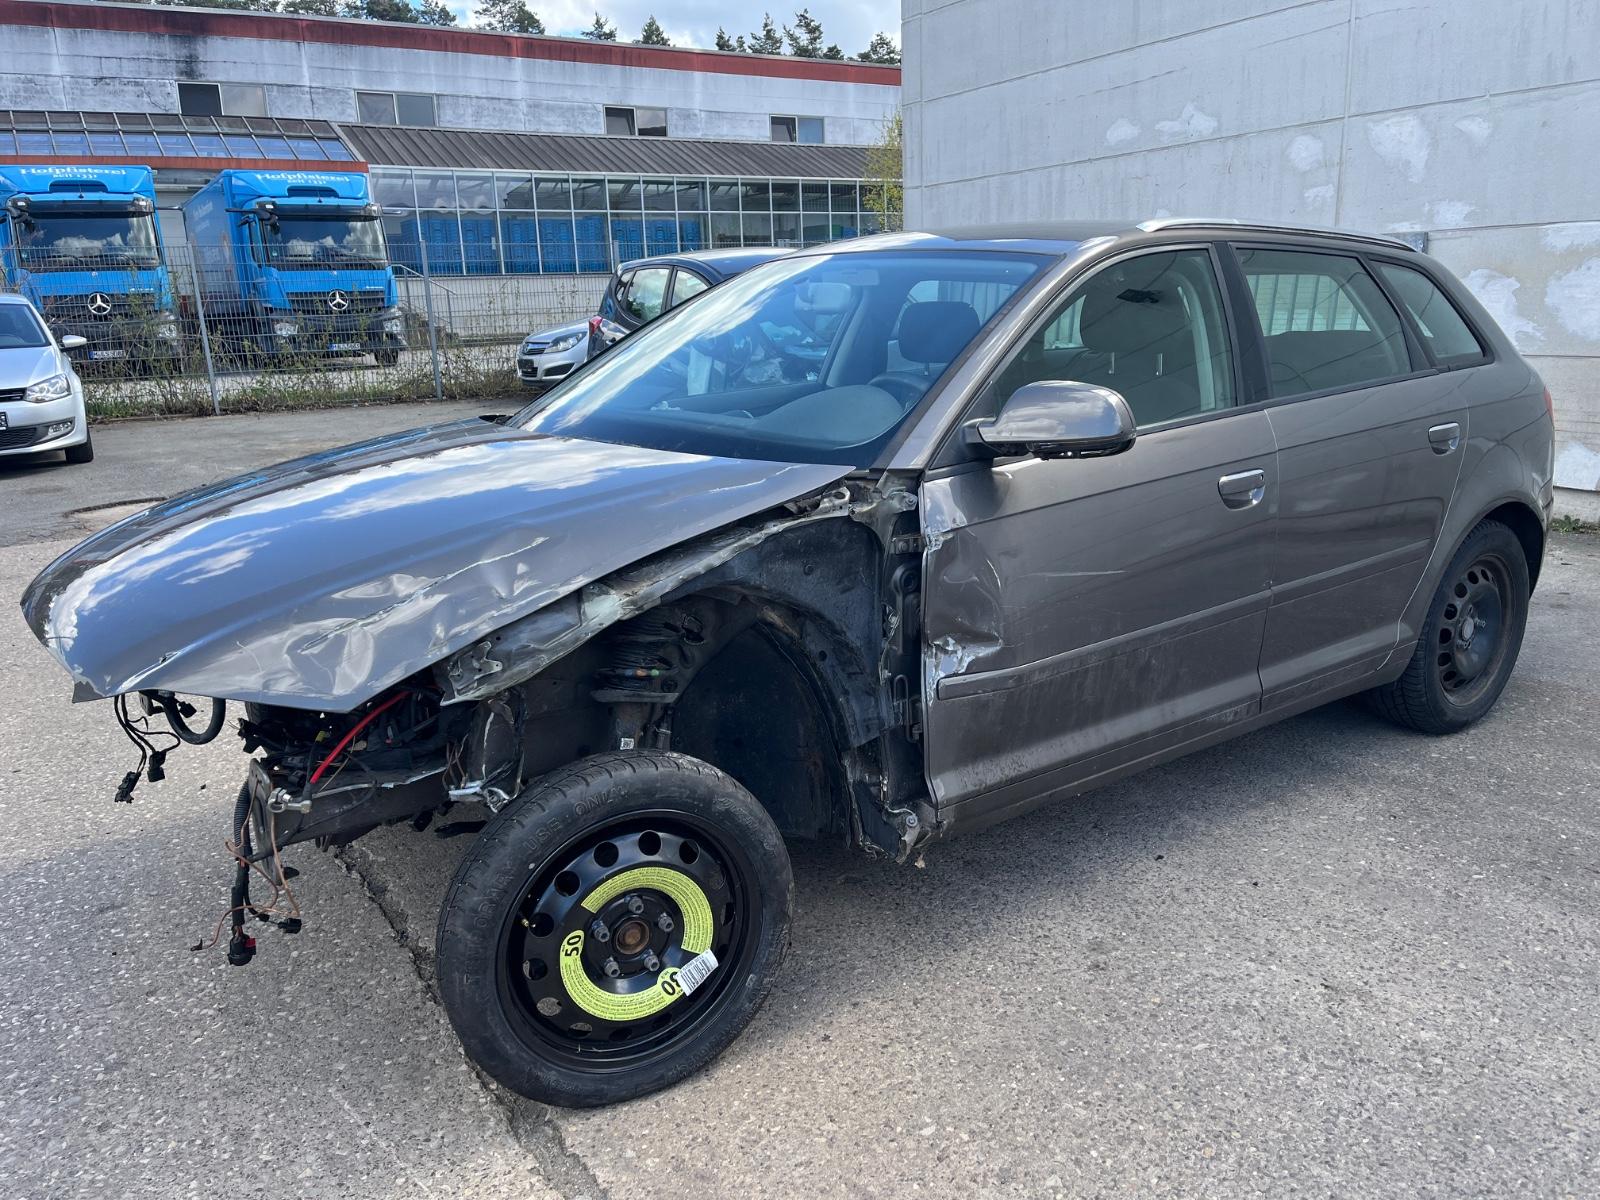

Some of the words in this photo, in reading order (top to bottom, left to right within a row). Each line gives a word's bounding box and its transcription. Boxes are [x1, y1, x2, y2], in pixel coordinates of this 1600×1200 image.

[20, 166, 127, 176] Hofpfisterei
[256, 172, 350, 182] Hofpfisterei
[523, 816, 563, 852] USE
[564, 934, 582, 958] 50
